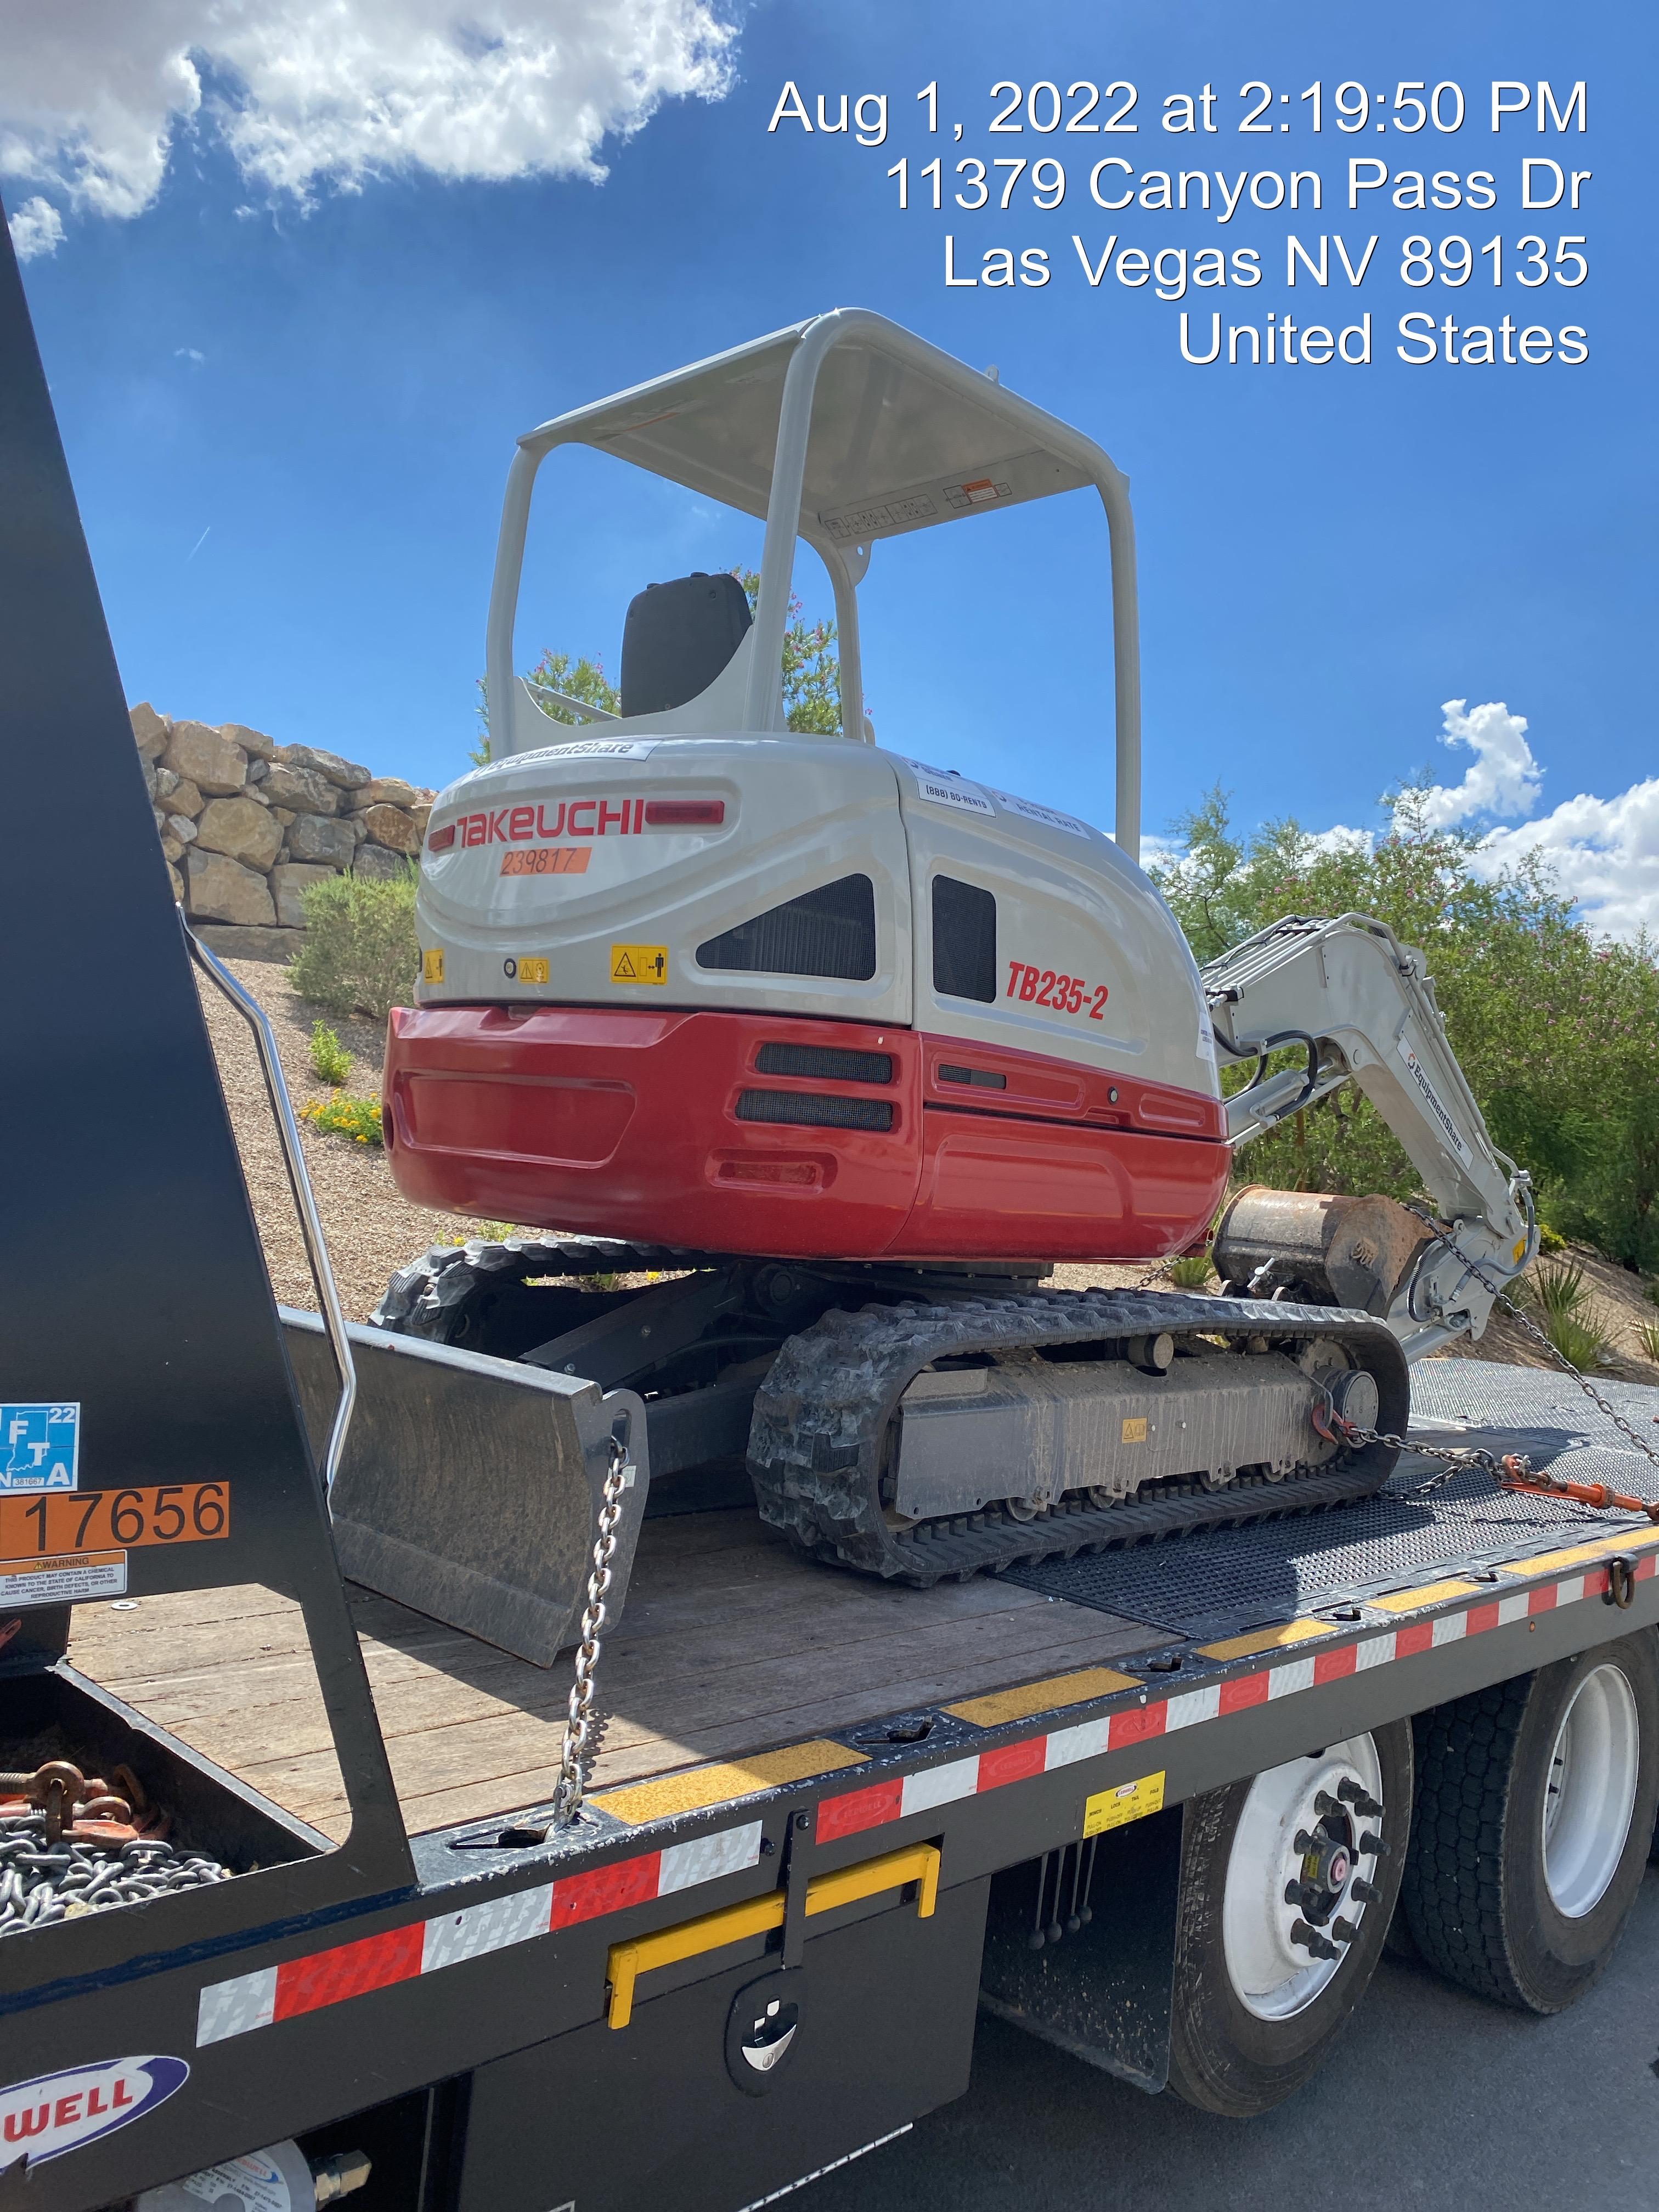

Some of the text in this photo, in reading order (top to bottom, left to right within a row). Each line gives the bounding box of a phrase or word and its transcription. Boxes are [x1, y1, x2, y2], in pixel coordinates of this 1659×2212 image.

[926, 785, 949, 799] (888)
[456, 799, 645, 848] TAKEUCHI
[501, 848, 578, 875] 239817
[1006, 961, 1109, 1020] TB235-2
[1414, 1063, 1463, 1152] EquipmentShare
[48, 1407, 76, 1424] 22
[25, 1483, 225, 1551] 17656
[42, 1557, 89, 1569] WARNING
[31, 1590, 74, 1599] REPRODUCTIVE
